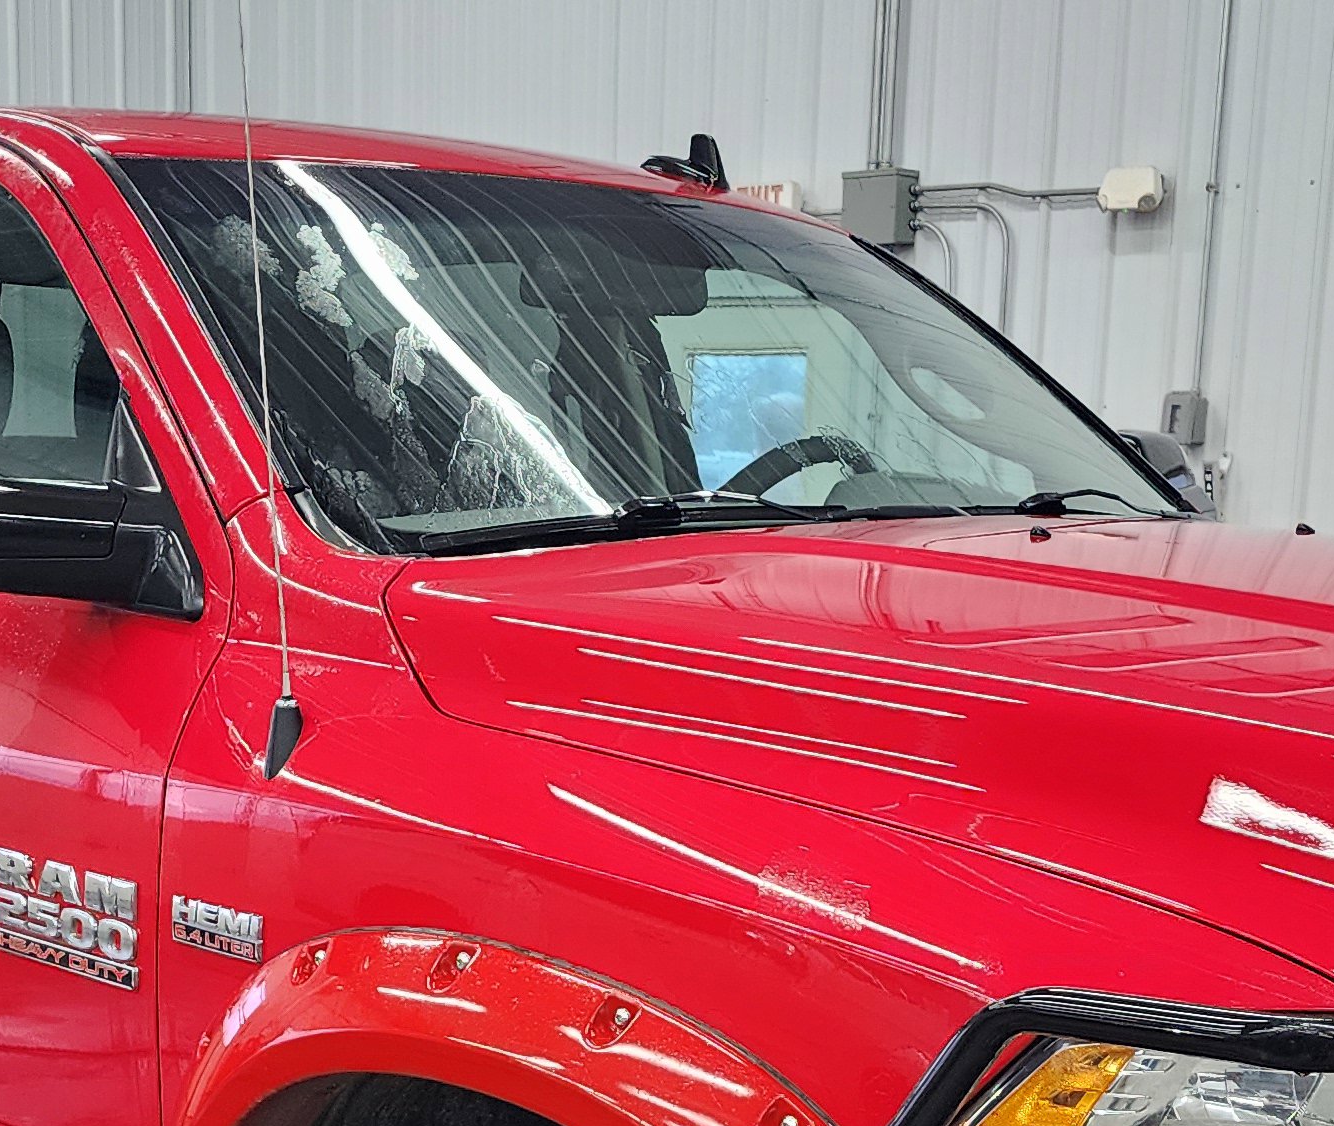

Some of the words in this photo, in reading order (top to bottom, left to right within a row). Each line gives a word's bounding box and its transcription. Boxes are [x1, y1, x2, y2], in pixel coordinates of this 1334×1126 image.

[737, 183, 784, 205] XIT
[172, 894, 264, 941] HEMI
[174, 923, 202, 944] 6.4
[204, 931, 254, 959] LITER
[68, 953, 129, 982] DUTY
